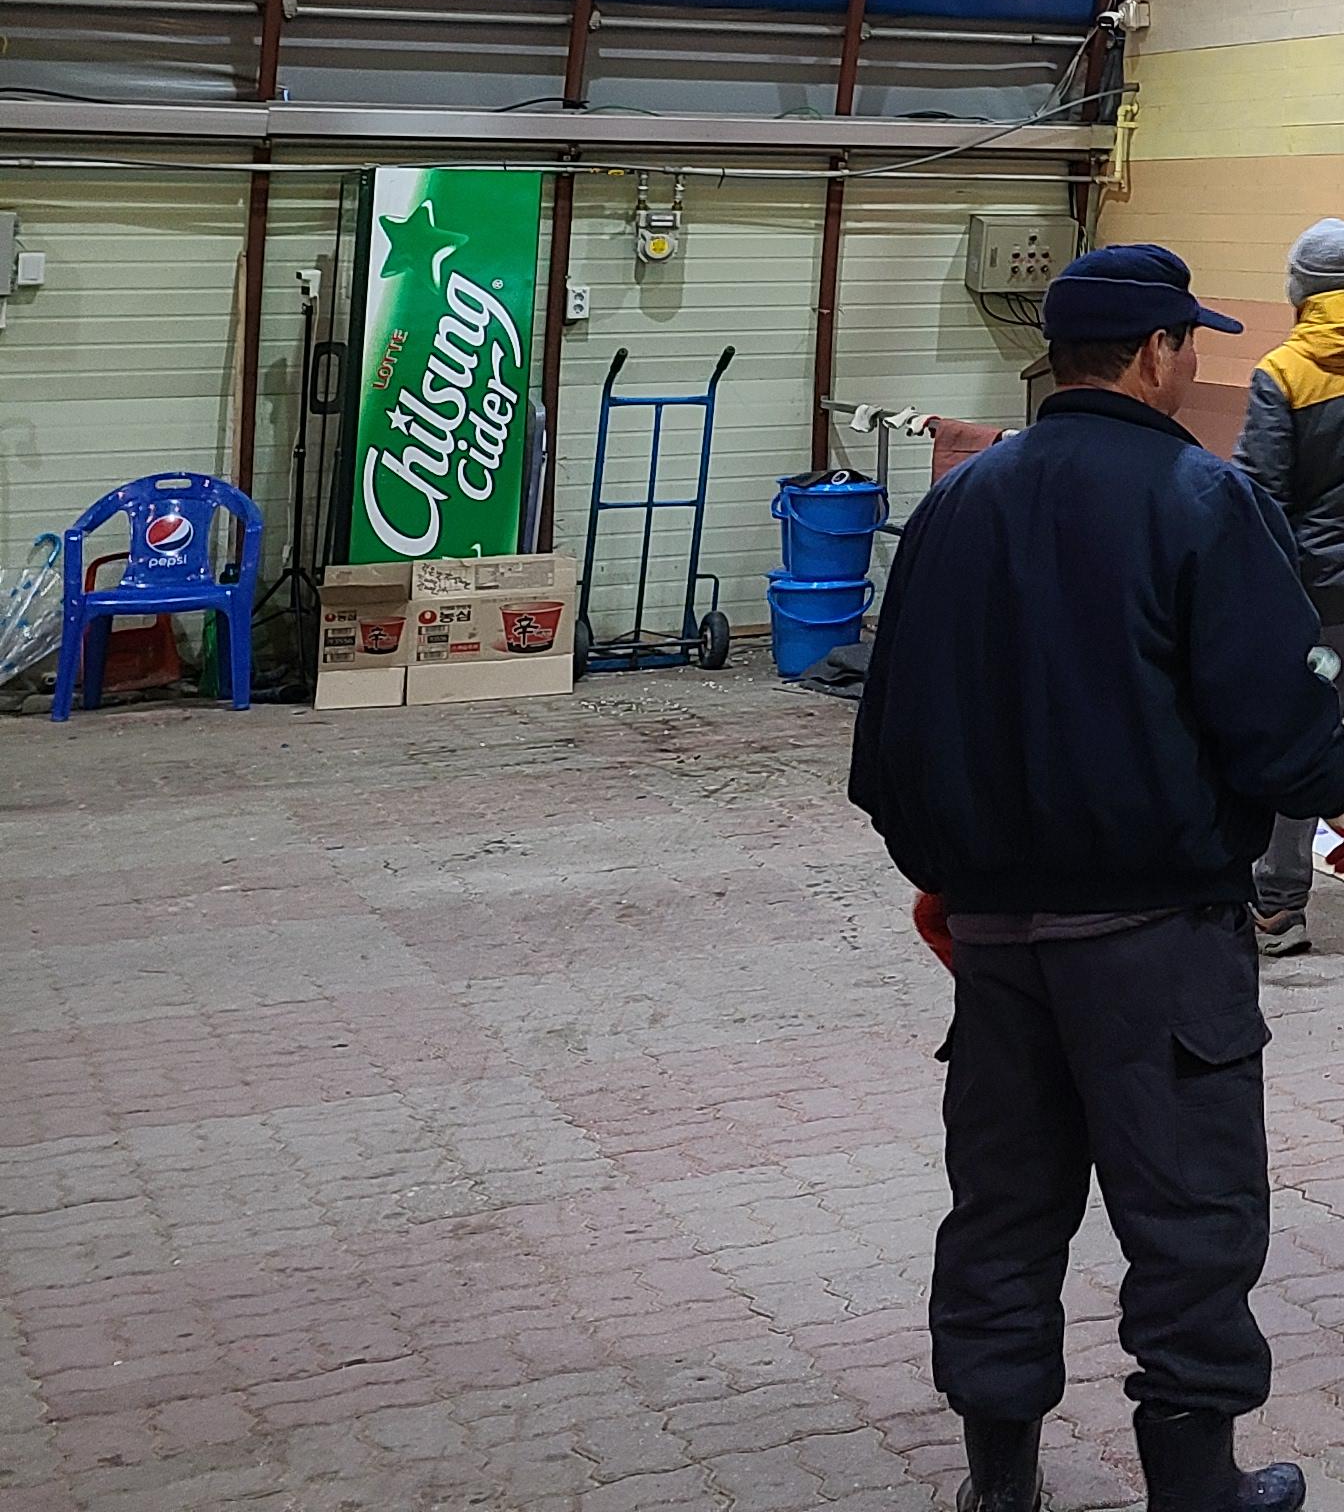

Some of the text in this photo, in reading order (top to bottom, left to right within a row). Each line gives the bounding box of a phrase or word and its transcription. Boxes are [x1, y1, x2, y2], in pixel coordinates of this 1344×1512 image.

[373, 328, 409, 390] LOTTE
[363, 271, 522, 557] Chilsung
[148, 555, 188, 568] pepsi
[512, 614, 540, 648] 辛
